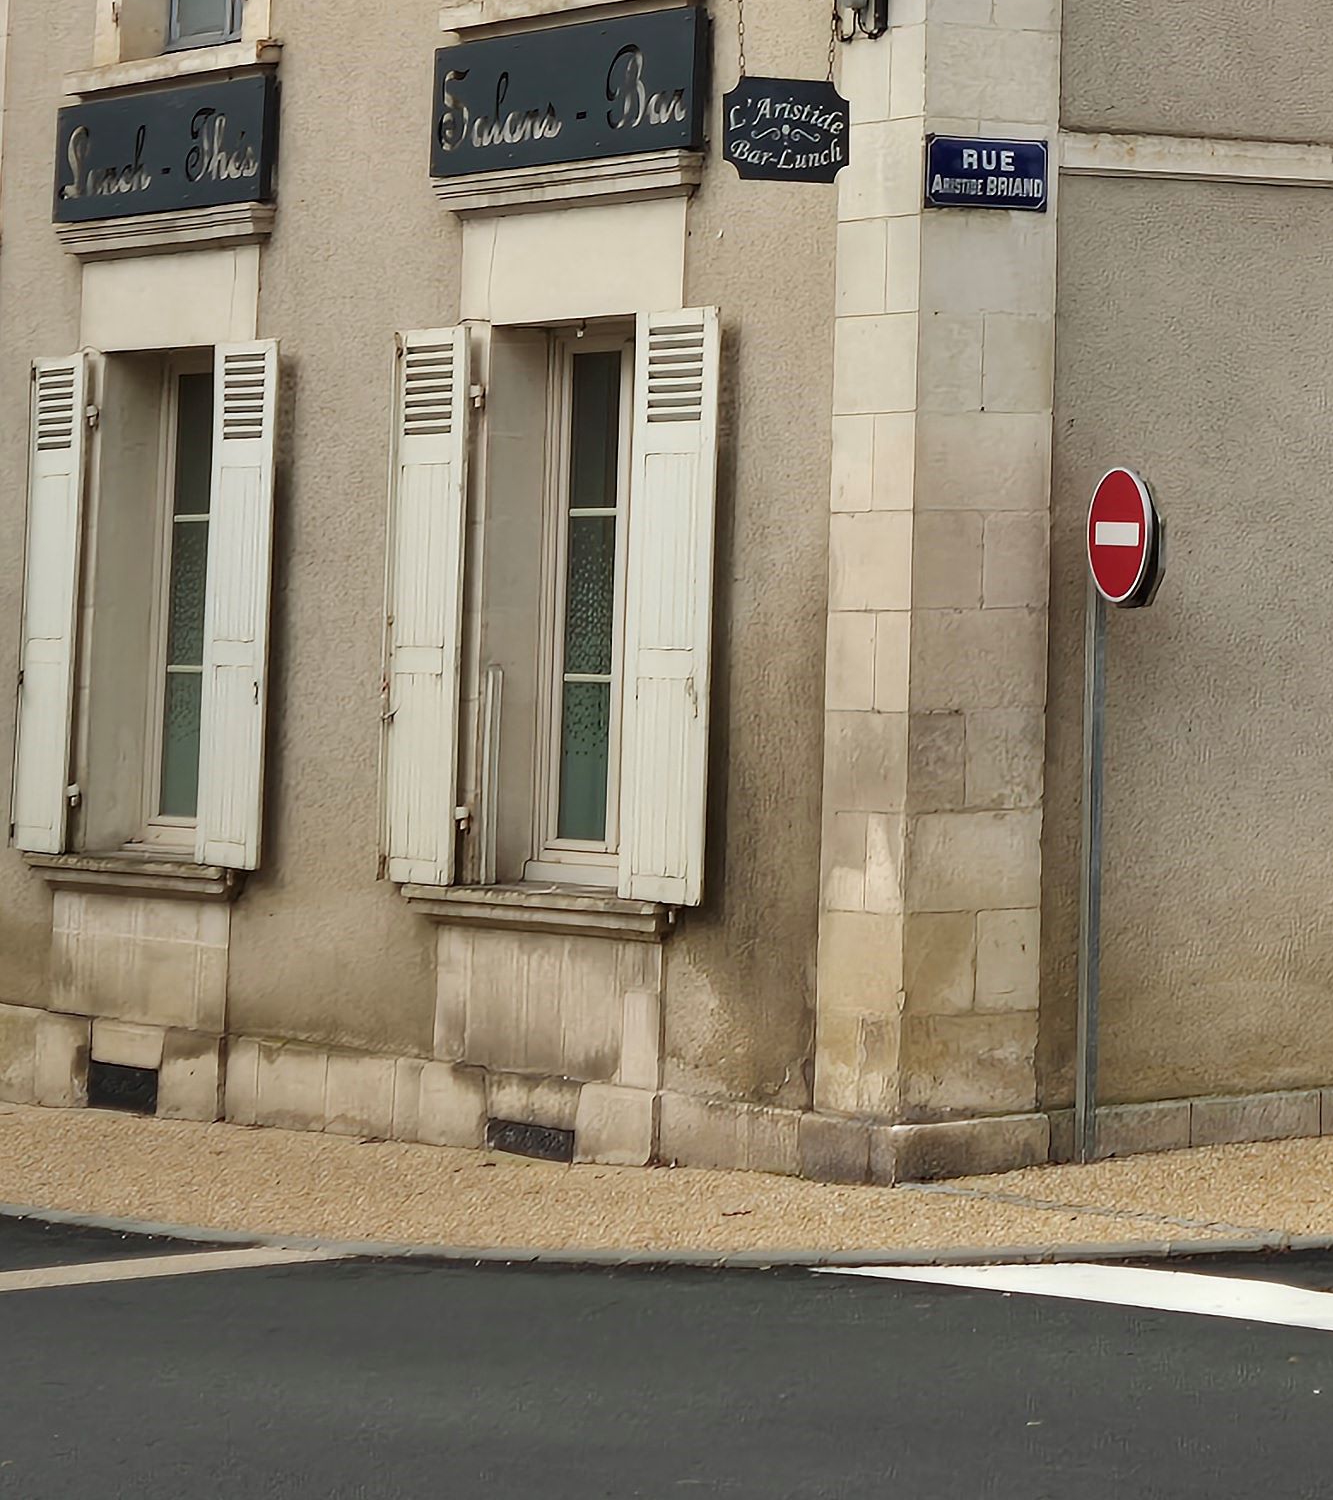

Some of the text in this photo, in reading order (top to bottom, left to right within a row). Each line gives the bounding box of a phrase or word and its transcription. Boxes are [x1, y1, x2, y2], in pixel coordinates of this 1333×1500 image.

[438, 69, 562, 151] Salons
[606, 43, 687, 130] Bar
[729, 97, 844, 135] L'Aristide
[58, 124, 152, 200] Lunch
[185, 107, 260, 182] Thés
[730, 138, 843, 170] Bar-Lunch
[962, 149, 1016, 172] RUE
[986, 176, 1043, 198] BRIAND
